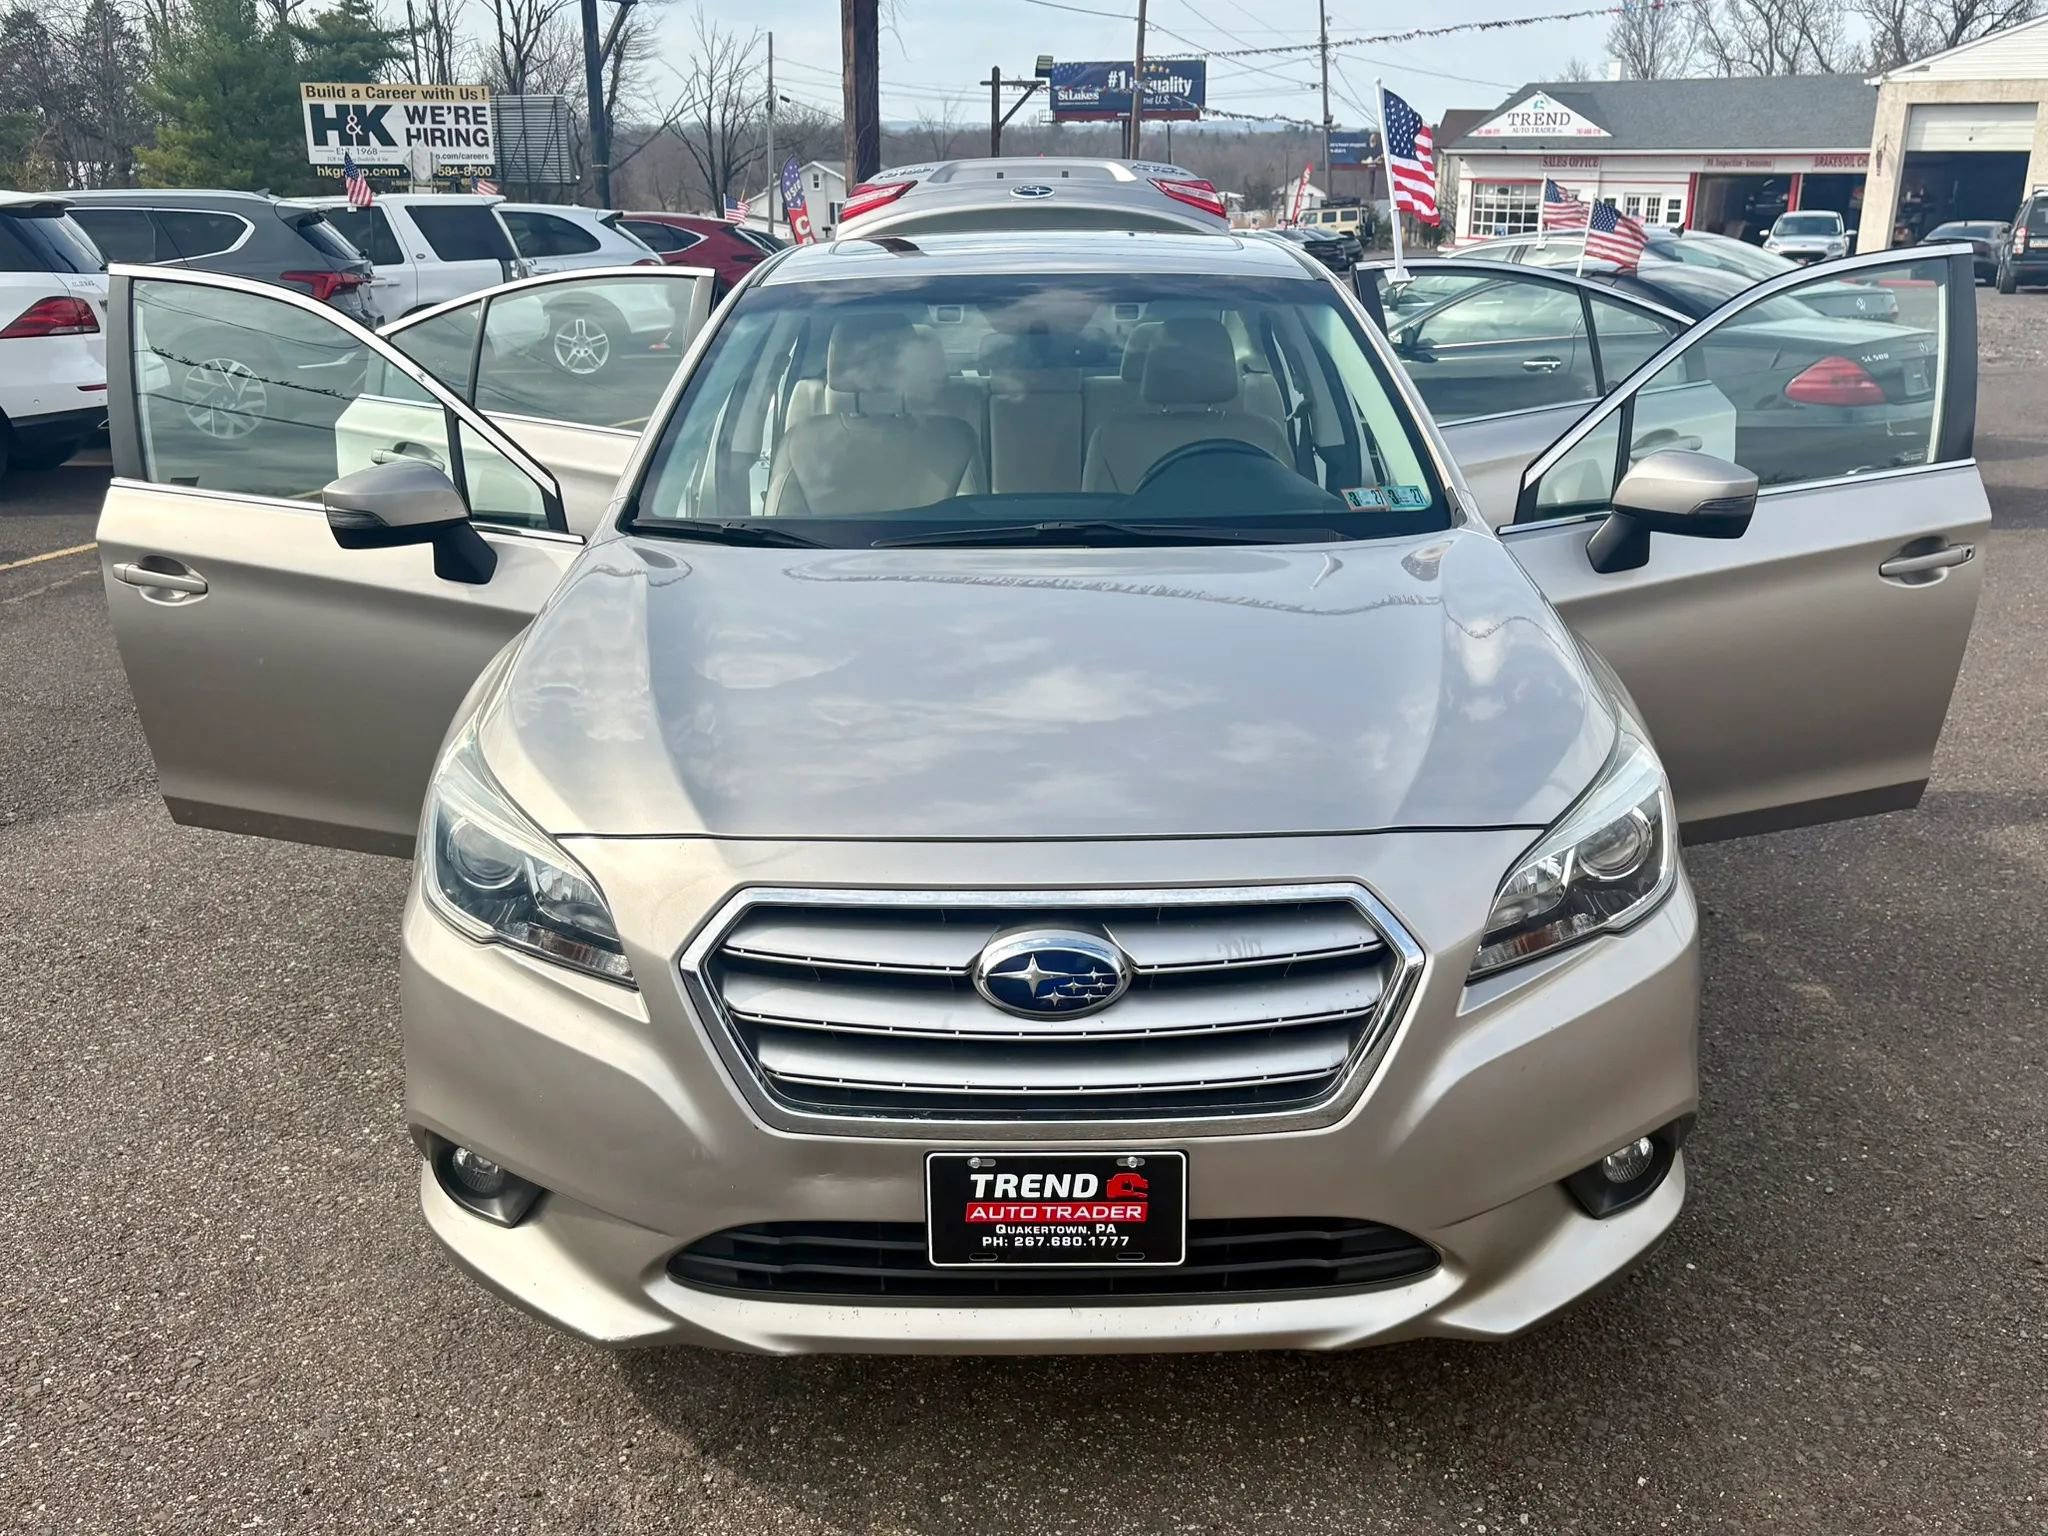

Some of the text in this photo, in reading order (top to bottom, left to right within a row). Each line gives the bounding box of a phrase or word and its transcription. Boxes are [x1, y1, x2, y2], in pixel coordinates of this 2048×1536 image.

[1108, 71, 1126, 89] #1
[305, 85, 346, 99] Build
[351, 88, 361, 98] a
[365, 87, 417, 100] Career
[421, 87, 455, 101] with
[404, 105, 488, 126] WE'RE
[1507, 112, 1571, 126] TREND
[309, 104, 398, 147] H&K
[406, 128, 490, 148] HIRING
[356, 147, 378, 155] 1968
[1542, 156, 1599, 168] SALES OFFICE
[317, 165, 400, 178] hkgrp.com
[970, 1173, 1099, 1199] TREND
[970, 1206, 1142, 1219] AUTO TRADER
[1096, 1224, 1116, 1234] PA
[982, 1237, 1130, 1247] PH: 267.680.1777
